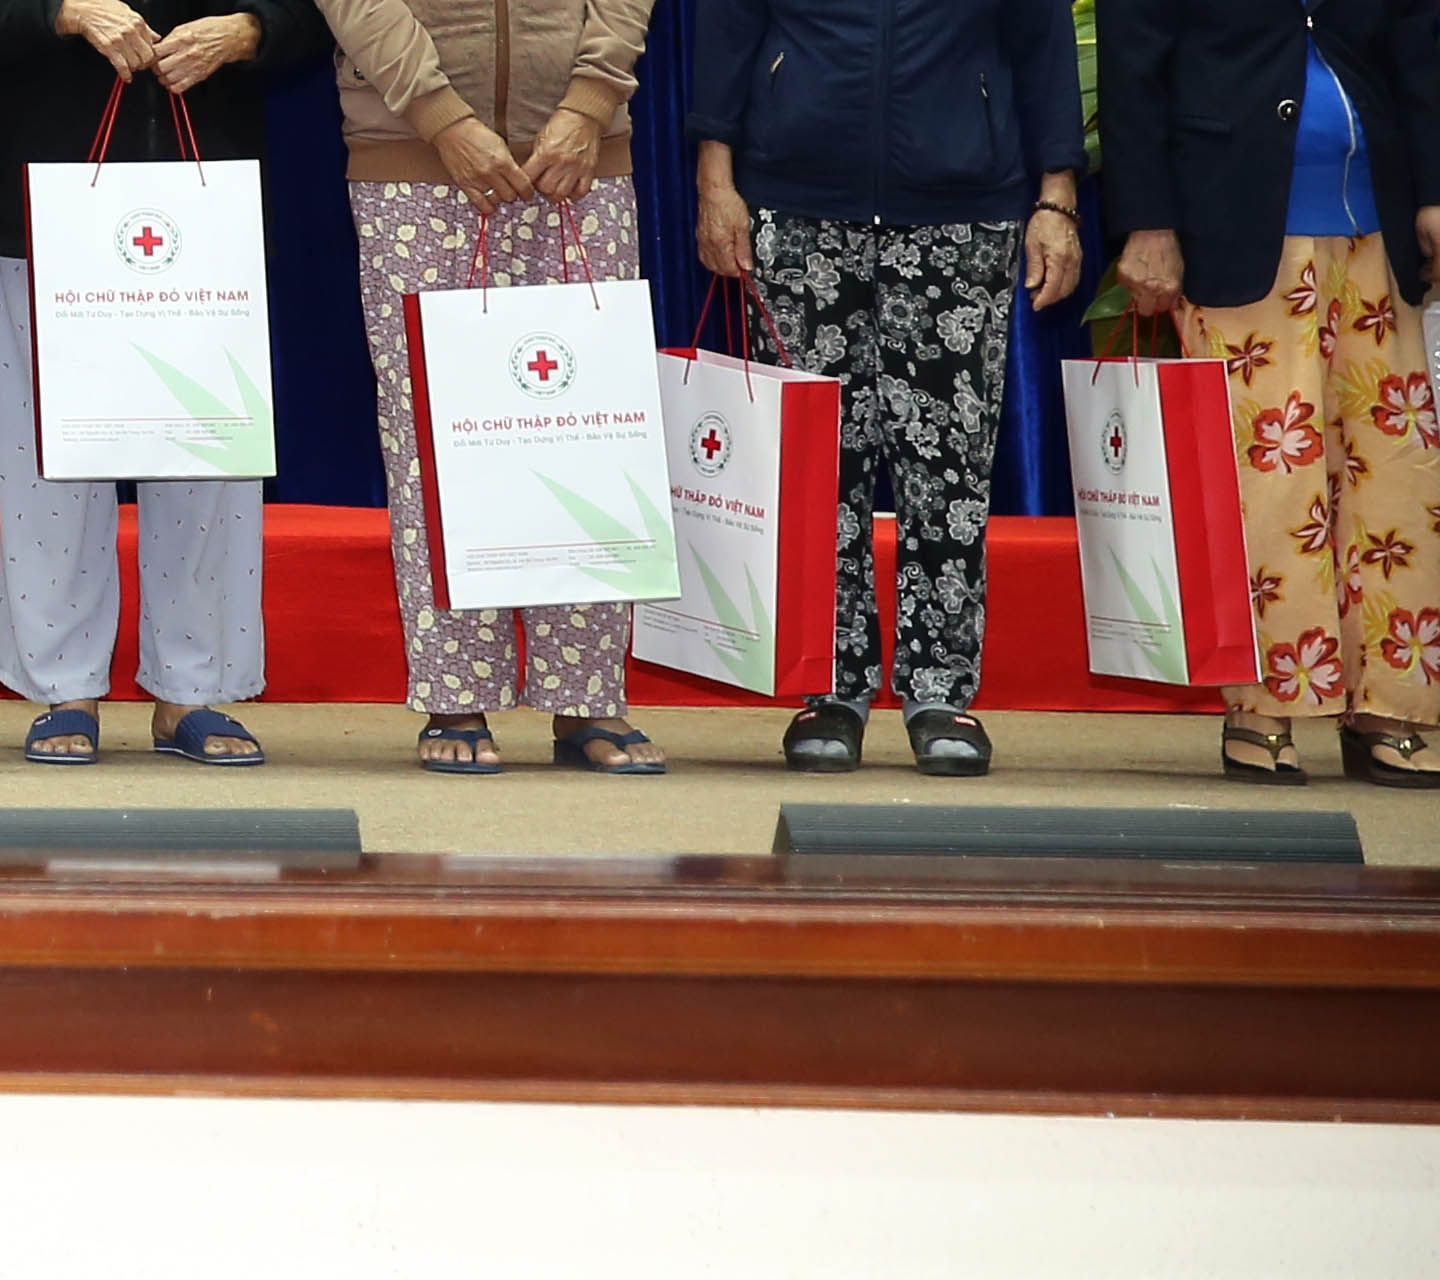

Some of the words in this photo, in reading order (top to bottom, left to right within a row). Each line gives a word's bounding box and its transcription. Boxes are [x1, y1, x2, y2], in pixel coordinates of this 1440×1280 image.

[55, 289, 80, 306] HỘI
[85, 289, 115, 303] CHỮ
[119, 289, 154, 306] THẬP
[158, 288, 180, 302] ĐỎ
[184, 288, 212, 304] VIỆT
[216, 290, 249, 302] NAM
